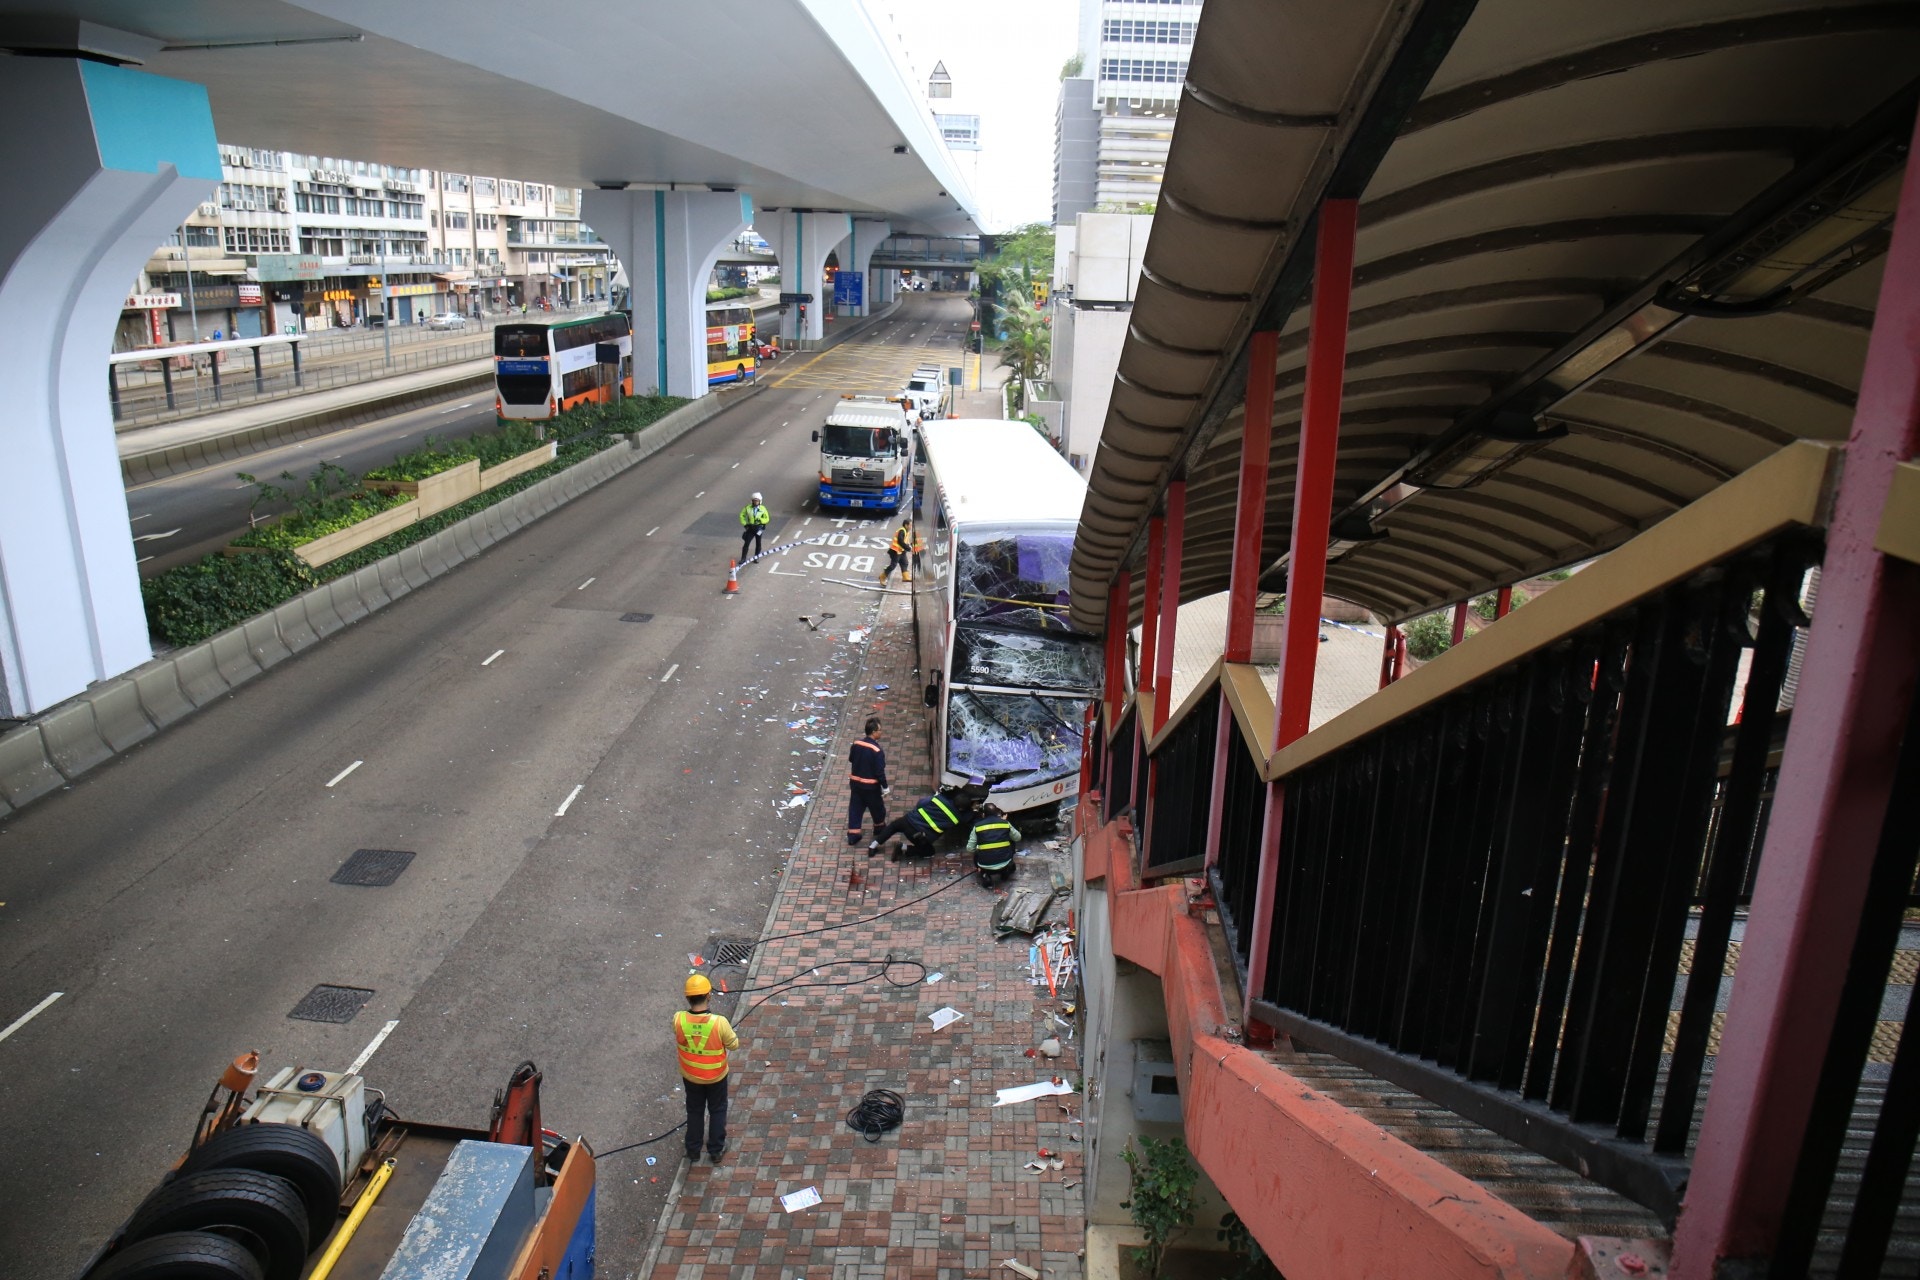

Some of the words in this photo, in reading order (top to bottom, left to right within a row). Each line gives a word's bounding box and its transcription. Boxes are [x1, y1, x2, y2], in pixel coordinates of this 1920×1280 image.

[805, 533, 892, 549] STOP
[803, 553, 875, 573] BUS
[970, 665, 989, 675] 5590
